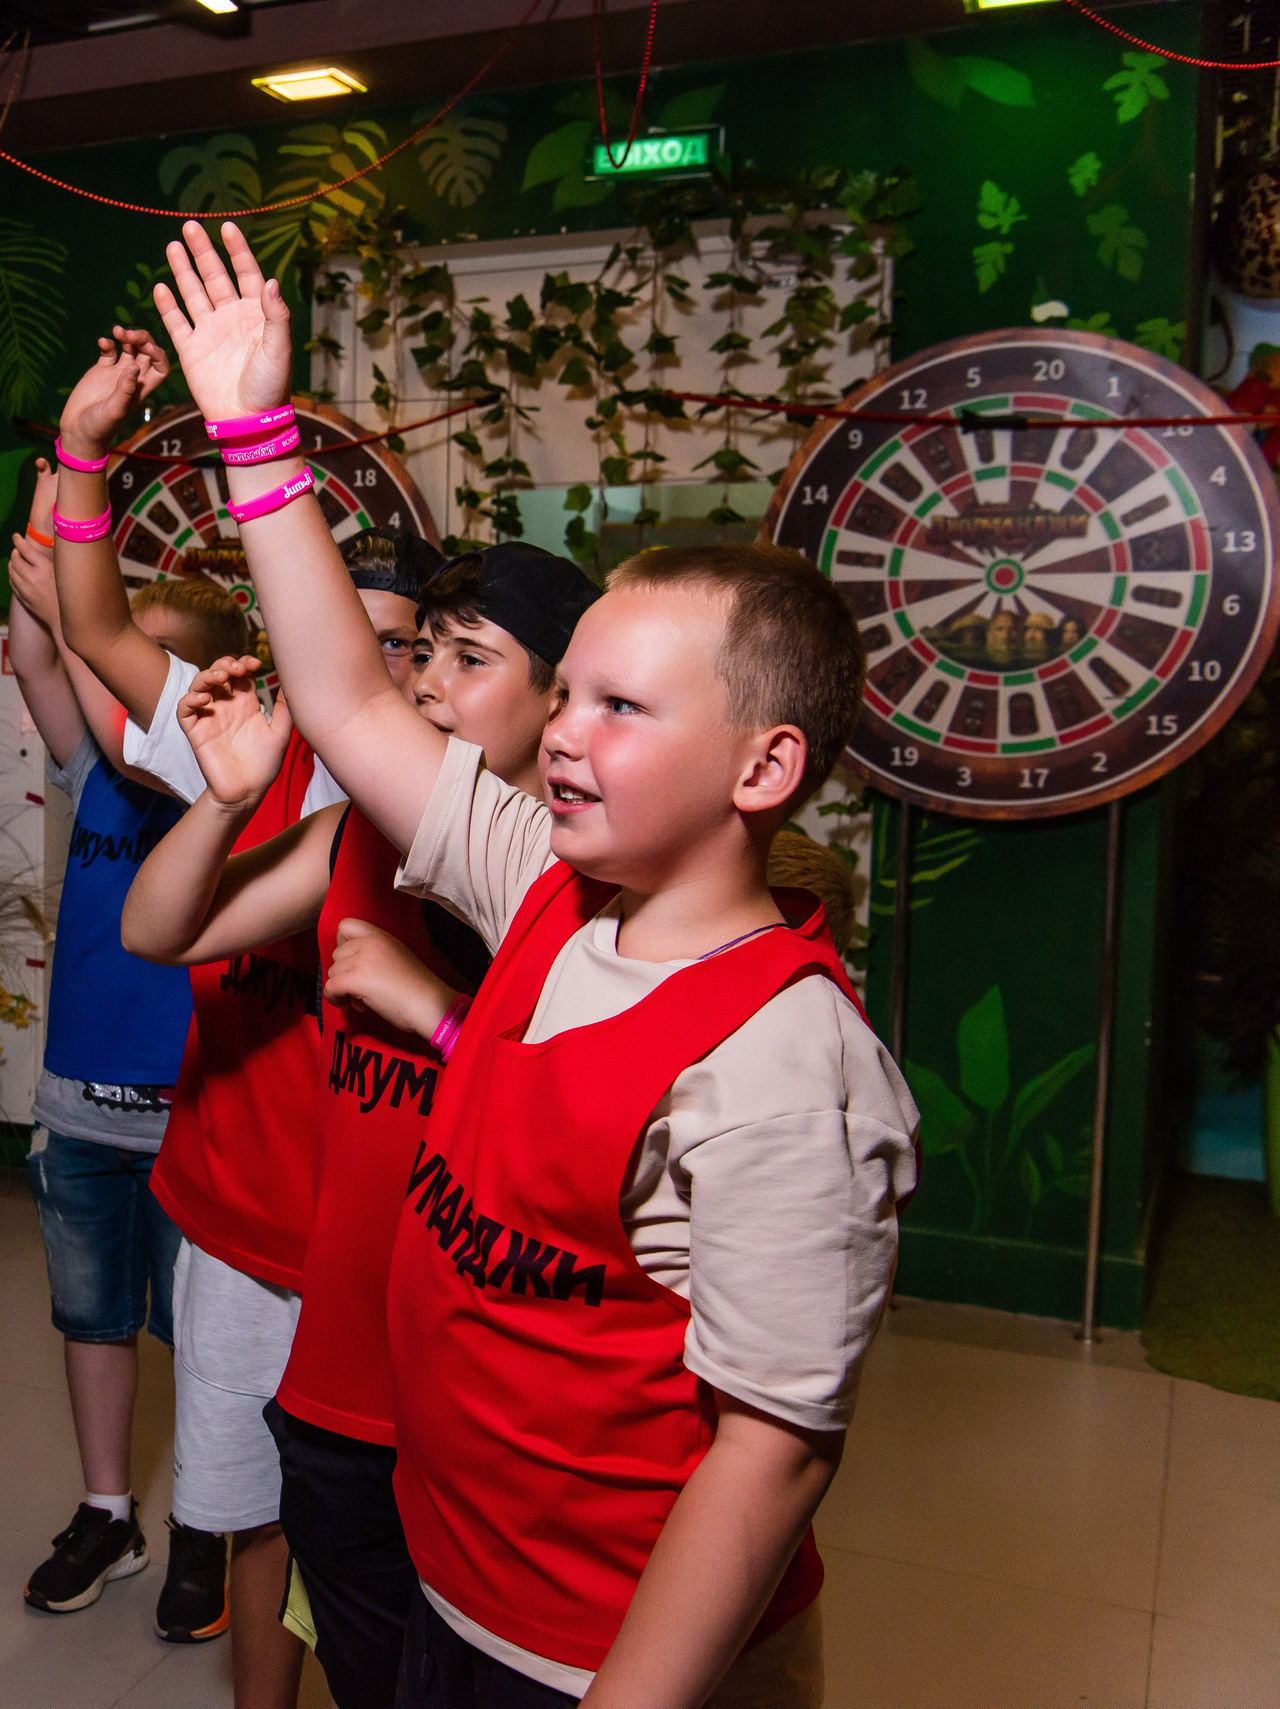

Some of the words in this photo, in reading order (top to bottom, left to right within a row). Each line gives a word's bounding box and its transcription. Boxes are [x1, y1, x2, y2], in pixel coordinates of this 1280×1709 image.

[597, 137, 706, 168] ВЫХОД
[965, 367, 982, 389] 5
[1033, 359, 1066, 384] 20
[1107, 376, 1122, 398] 1
[899, 389, 928, 411] 12
[160, 438, 182, 457] 12
[313, 434, 323, 451] 1
[847, 429, 863, 450] 9
[121, 471, 135, 490] 9
[353, 469, 378, 488] 18
[1209, 466, 1228, 487] 4
[800, 484, 830, 505] 14
[388, 511, 402, 530] 4
[1221, 531, 1257, 554] 13
[1222, 596, 1241, 618] 6
[1187, 660, 1222, 683] 10
[1145, 714, 1180, 737] 15
[889, 746, 920, 768] 19
[1091, 752, 1109, 774] 2
[956, 767, 973, 788] 3
[1019, 768, 1050, 790] 17
[328, 1029, 439, 1117] ДЖУМ
